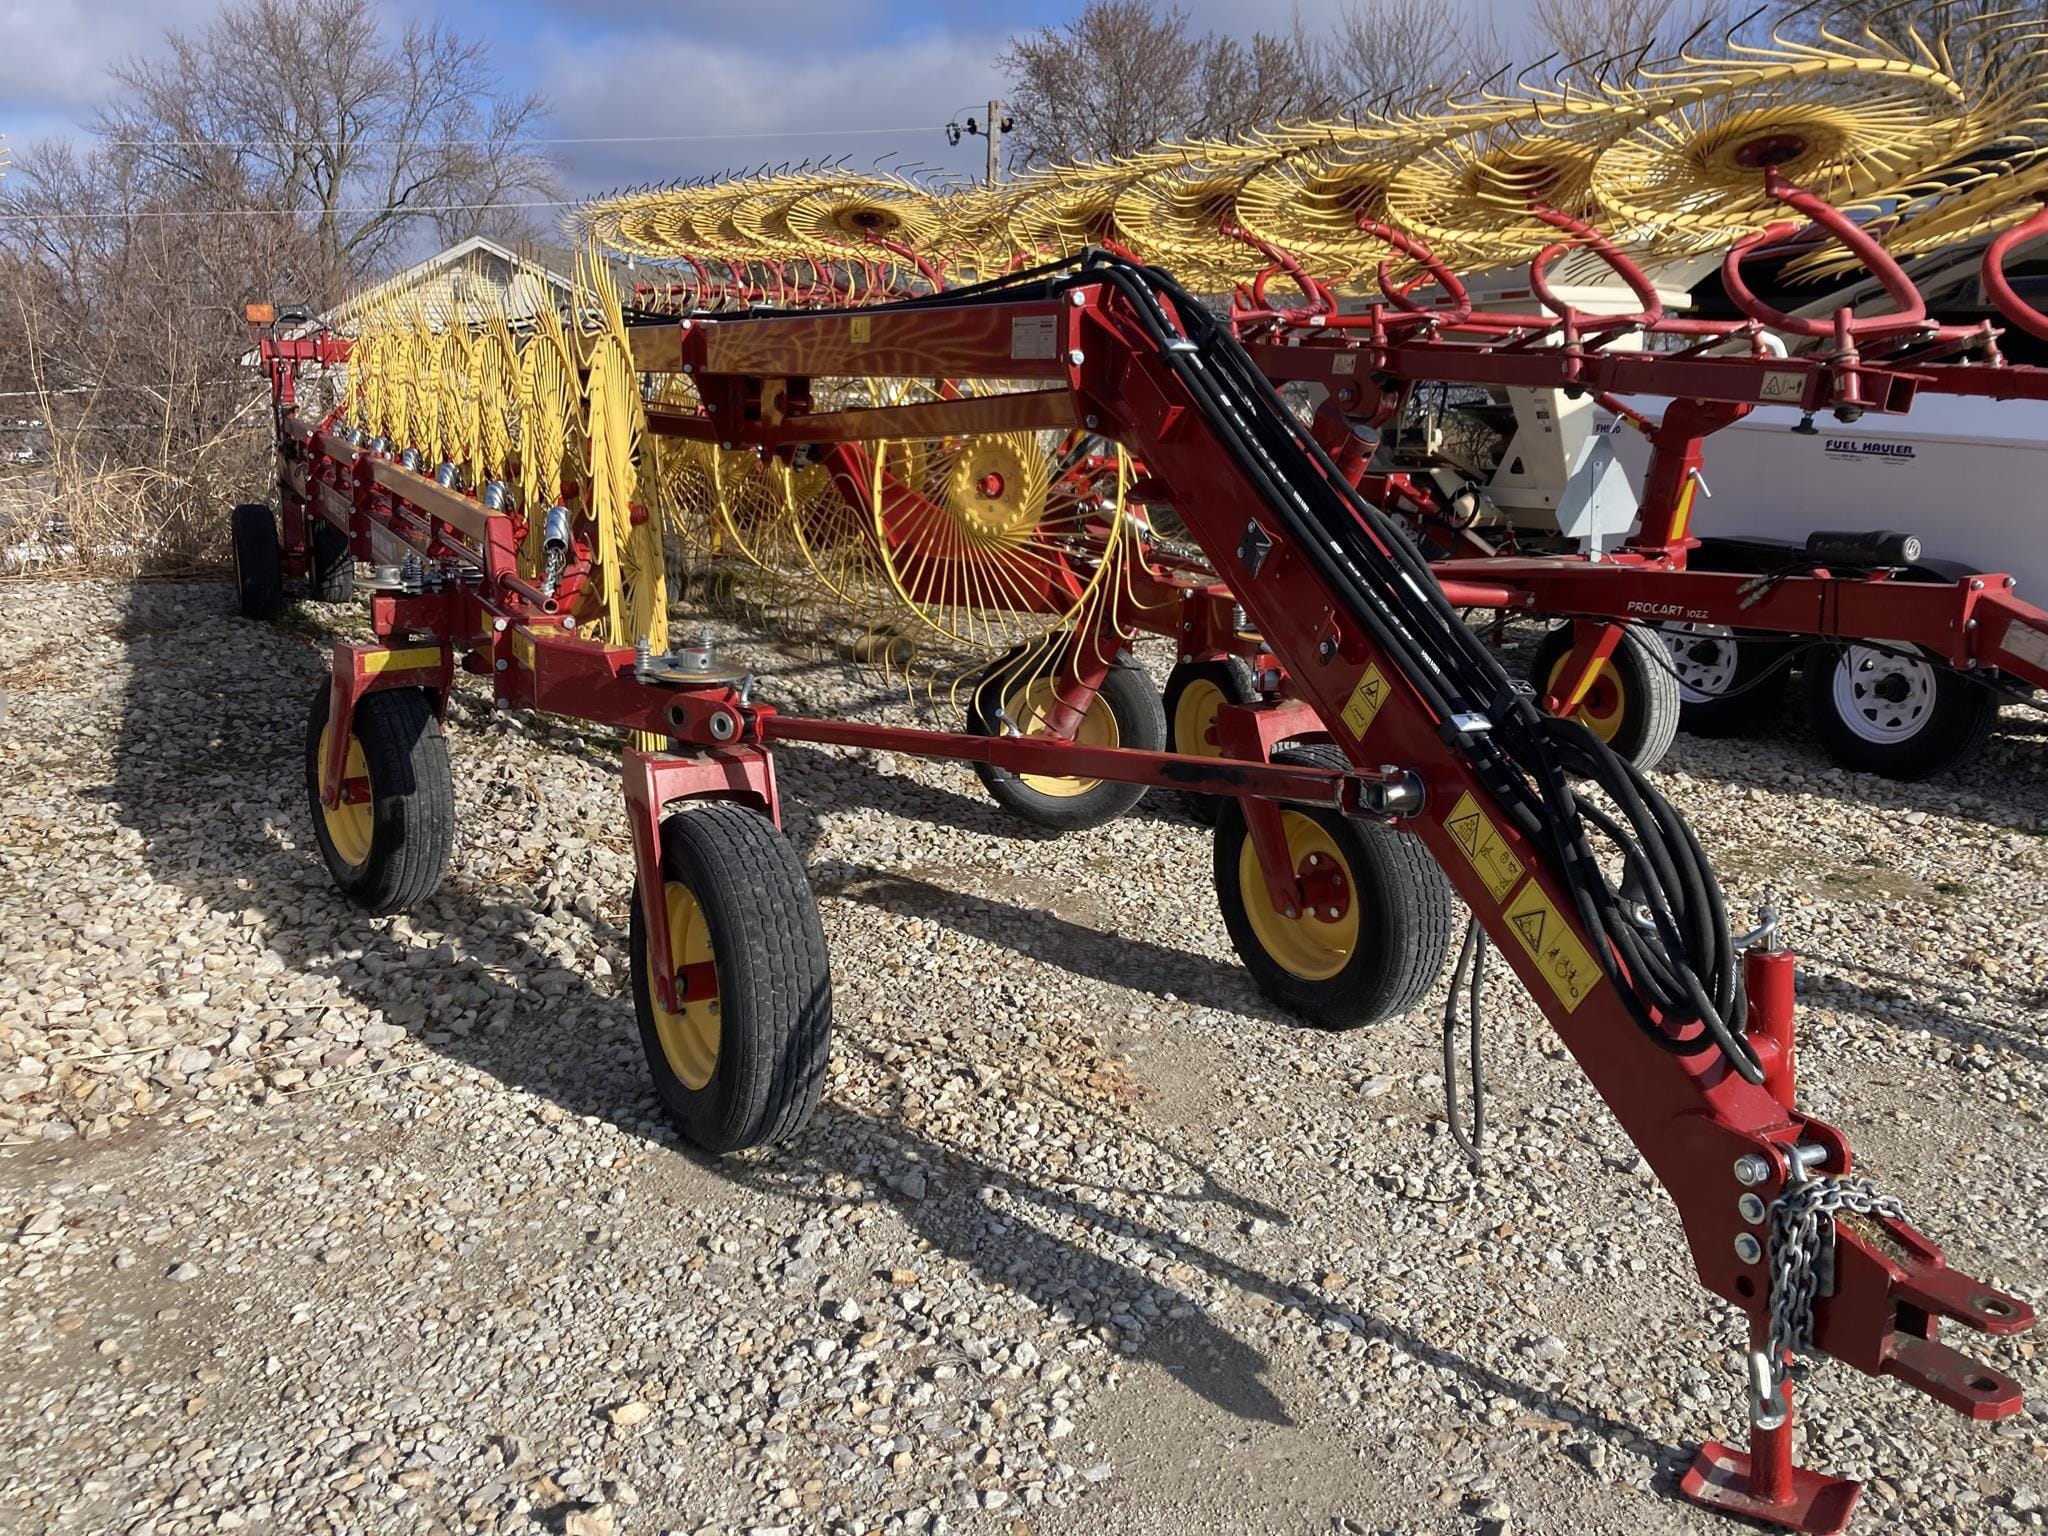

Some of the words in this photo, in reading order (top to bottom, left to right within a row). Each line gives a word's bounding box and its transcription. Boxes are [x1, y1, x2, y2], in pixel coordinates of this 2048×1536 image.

[1825, 440, 1857, 451] FUEL
[1862, 443, 1913, 454] HAULER
[1627, 601, 1684, 616] PROCART
[1686, 610, 1709, 619] 1022
